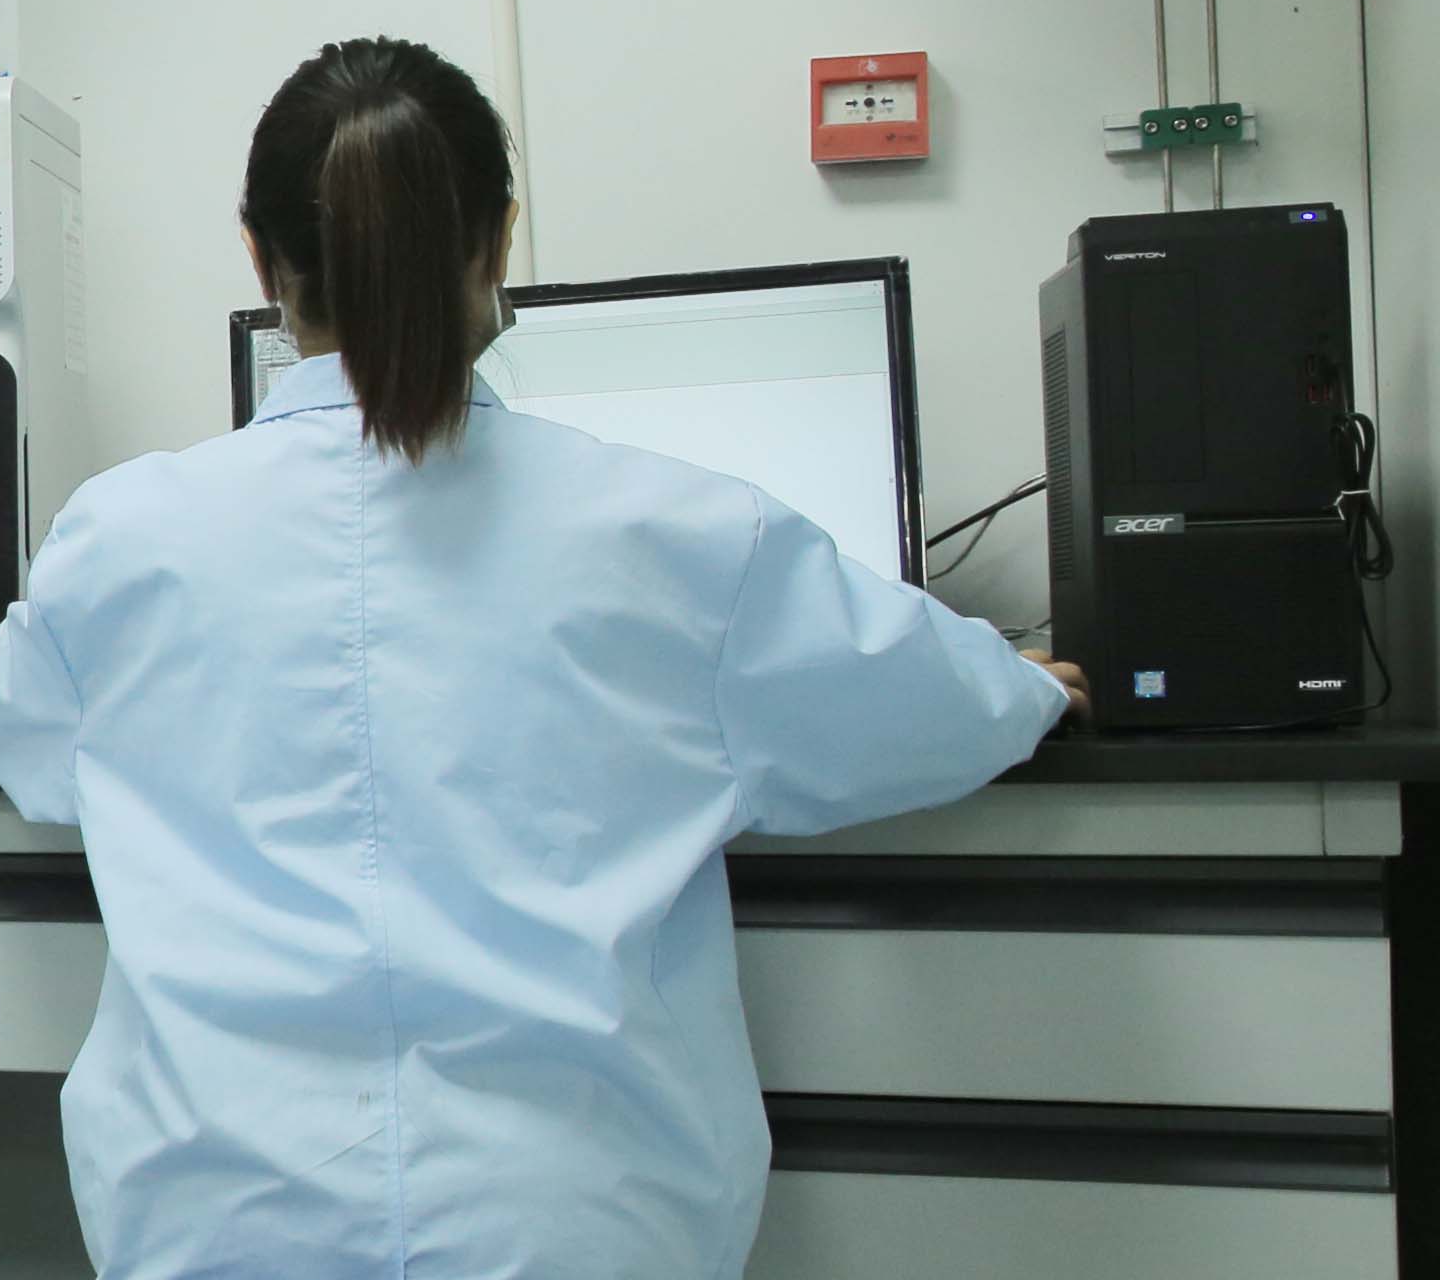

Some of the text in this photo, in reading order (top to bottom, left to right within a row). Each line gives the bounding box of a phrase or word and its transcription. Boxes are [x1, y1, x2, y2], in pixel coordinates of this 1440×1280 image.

[1104, 252, 1166, 260] VERITON
[1115, 518, 1175, 532] acer
[1299, 680, 1342, 688] HDMI
